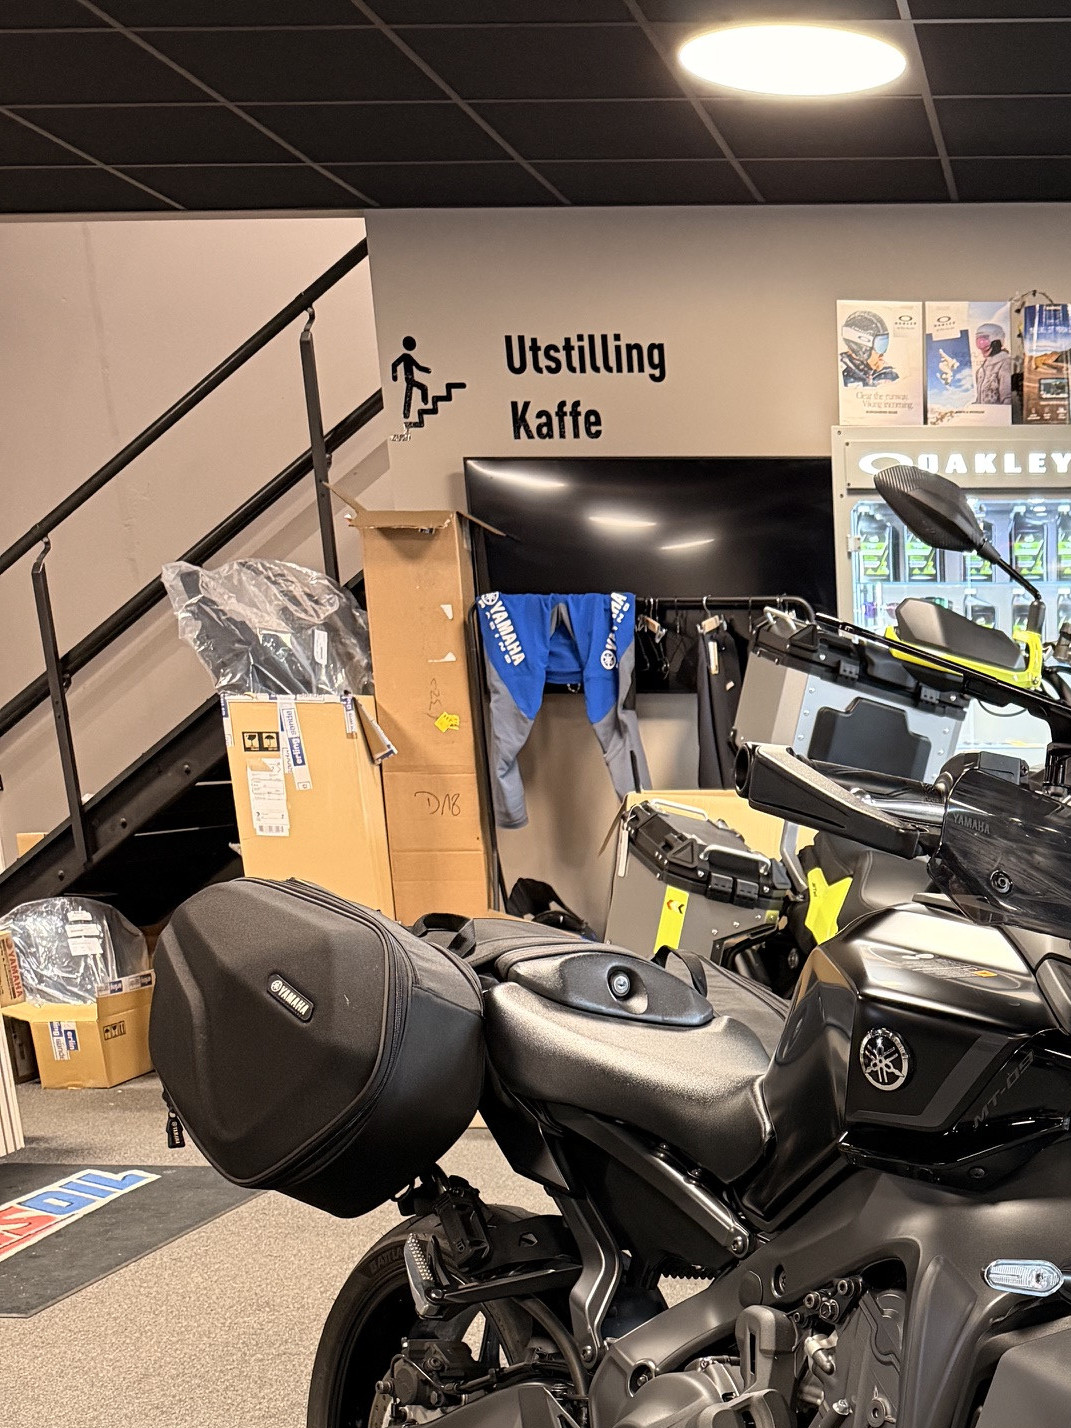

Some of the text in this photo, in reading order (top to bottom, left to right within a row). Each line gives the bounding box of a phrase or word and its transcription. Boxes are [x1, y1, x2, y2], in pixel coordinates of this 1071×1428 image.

[504, 333, 666, 383] Utstilling
[510, 399, 602, 440] Kaffe
[490, 600, 526, 667] YAMAHA
[953, 813, 990, 835] YAMAHA
[9, 951, 23, 998] YAMAHA
[278, 985, 309, 1015] YAMAHA
